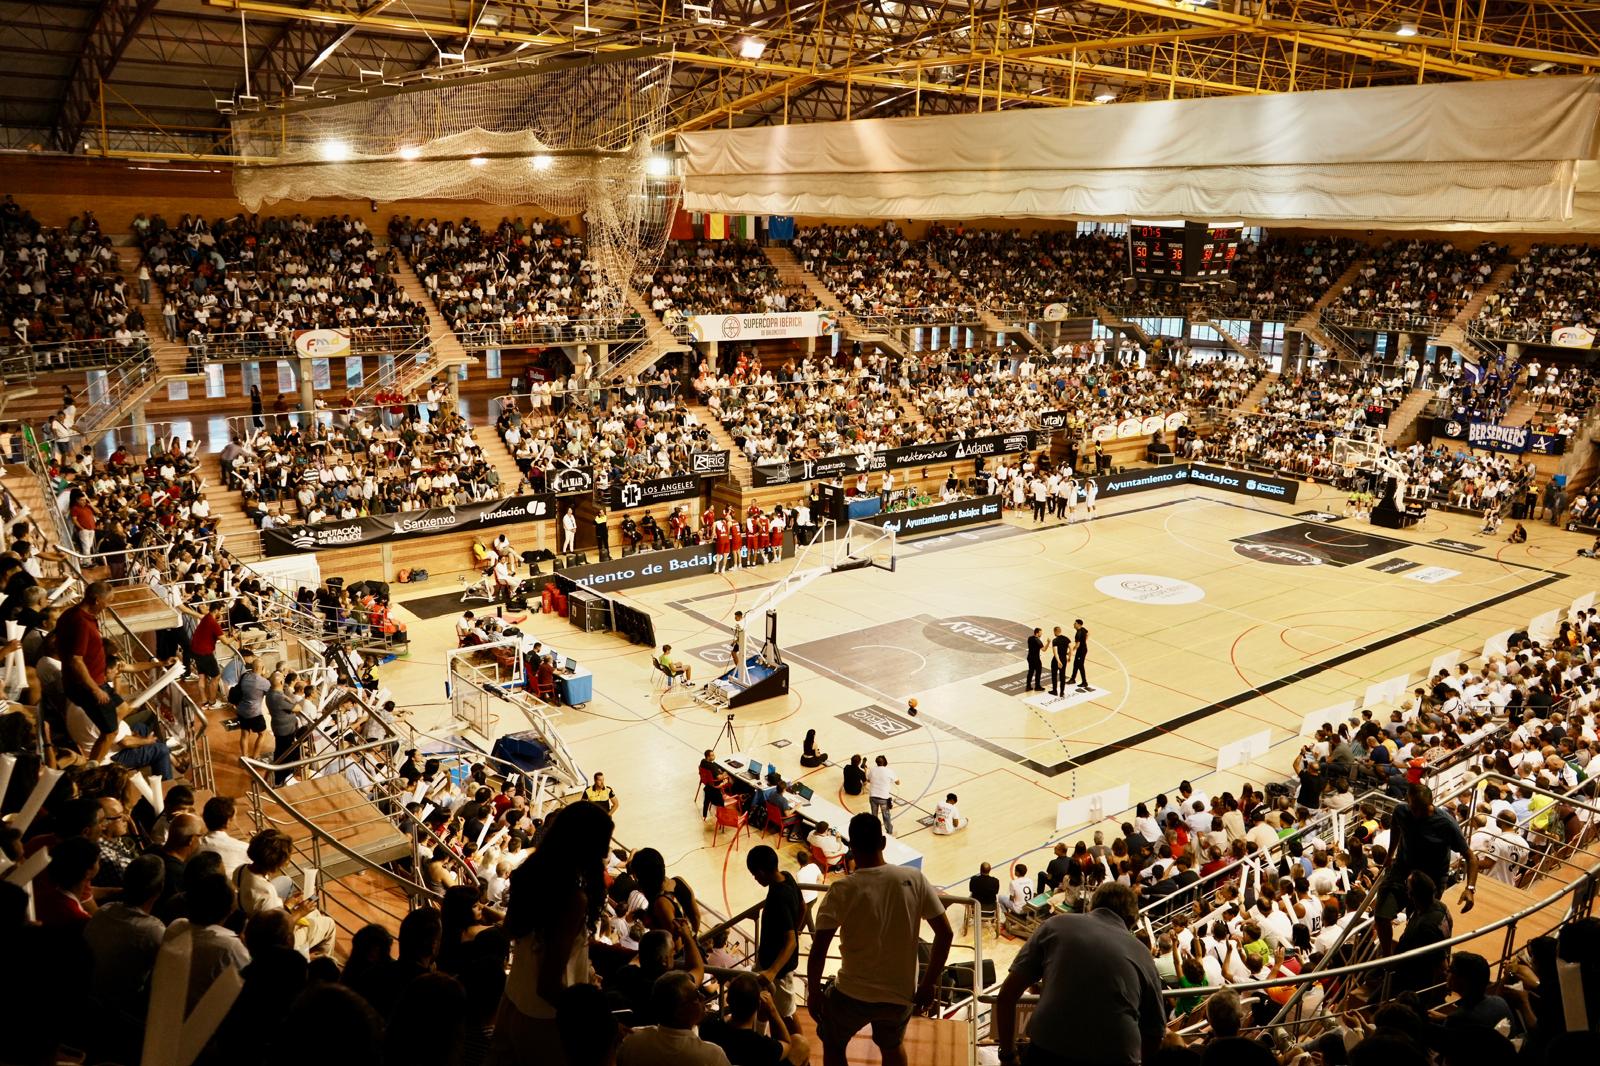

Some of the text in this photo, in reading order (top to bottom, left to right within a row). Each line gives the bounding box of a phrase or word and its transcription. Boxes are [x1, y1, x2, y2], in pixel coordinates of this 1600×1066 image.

[1136, 246, 1147, 257] 50
[1172, 249, 1183, 259] 38
[743, 317, 778, 329] SUPERCOPA
[1043, 415, 1066, 427] vitaly
[1469, 423, 1528, 448] BERSERKERS
[966, 442, 994, 455] Adarve
[561, 479, 569, 488] LA
[1106, 473, 1173, 491] Ayuntamiento
[1175, 470, 1187, 479] de
[1190, 469, 1239, 487] Badajoz
[643, 486, 658, 494] LOS
[1256, 484, 1286, 496] Badajoz
[479, 507, 525, 523] fundación
[905, 513, 949, 528] Ayuntamiento
[949, 510, 957, 520] de
[958, 507, 980, 519] Badajoz
[403, 515, 456, 531] Sanxenxo
[317, 525, 362, 539] DIPUTACIÓN
[327, 533, 362, 544] BADAJOZ
[641, 563, 663, 576] de
[1023, 886, 1032, 902] 9
